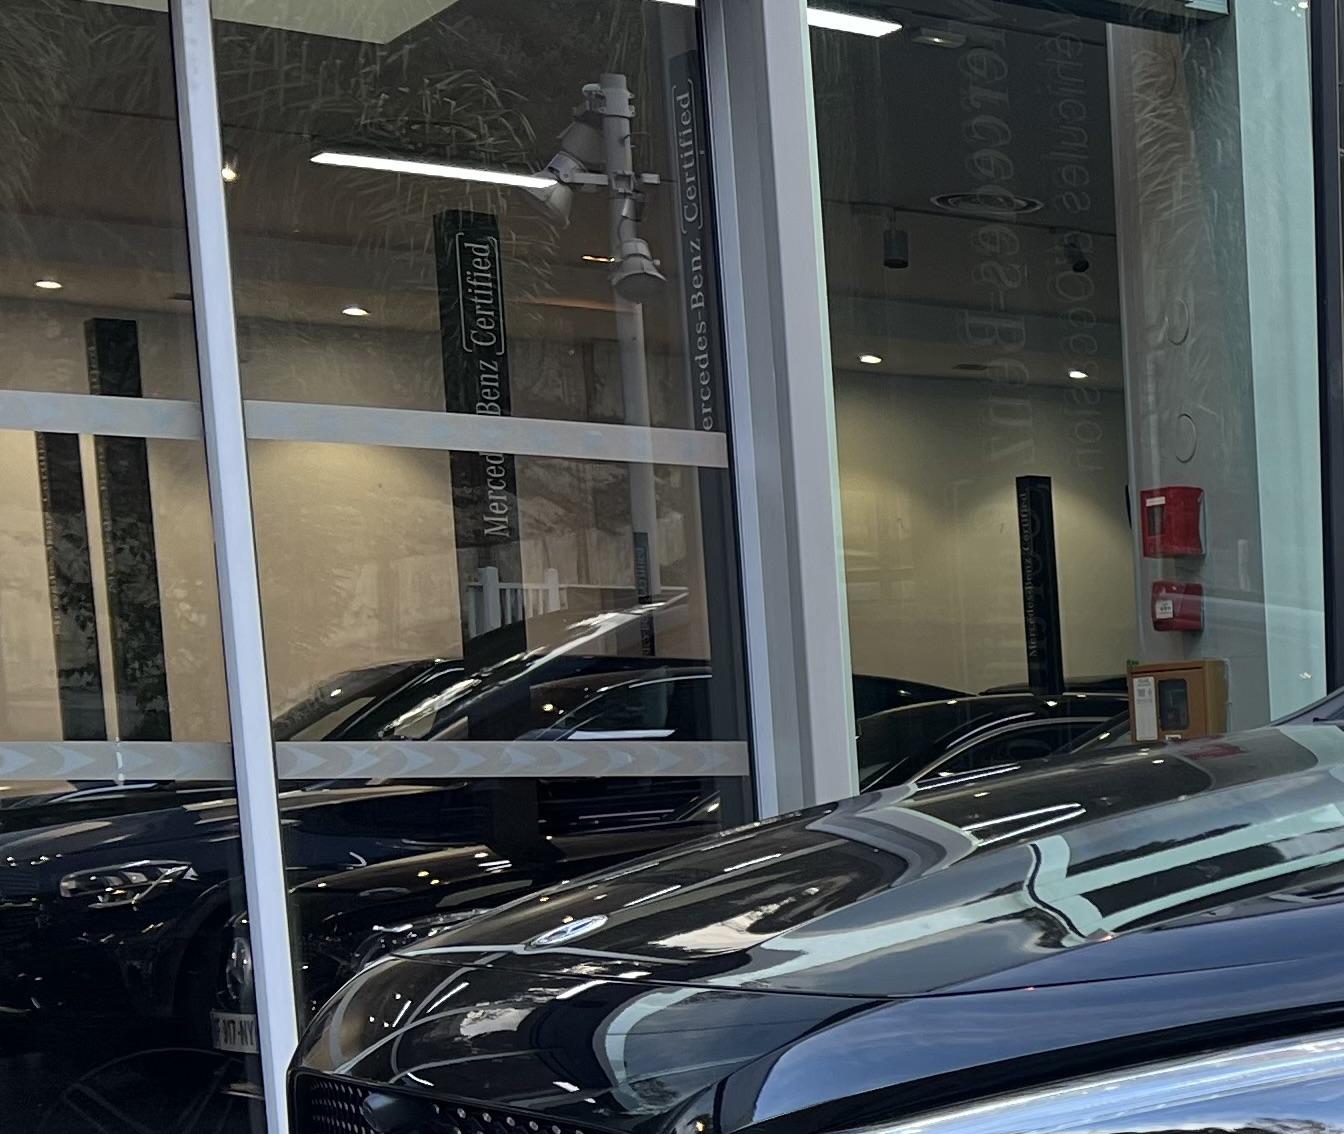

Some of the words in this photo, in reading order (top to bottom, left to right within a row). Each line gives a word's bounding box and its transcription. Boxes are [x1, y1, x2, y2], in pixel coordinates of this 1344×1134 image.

[677, 91, 699, 222] Certified
[463, 242, 497, 347] Certified
[689, 237, 714, 432] ercedes-Benz
[475, 359, 511, 538] MercedBenz
